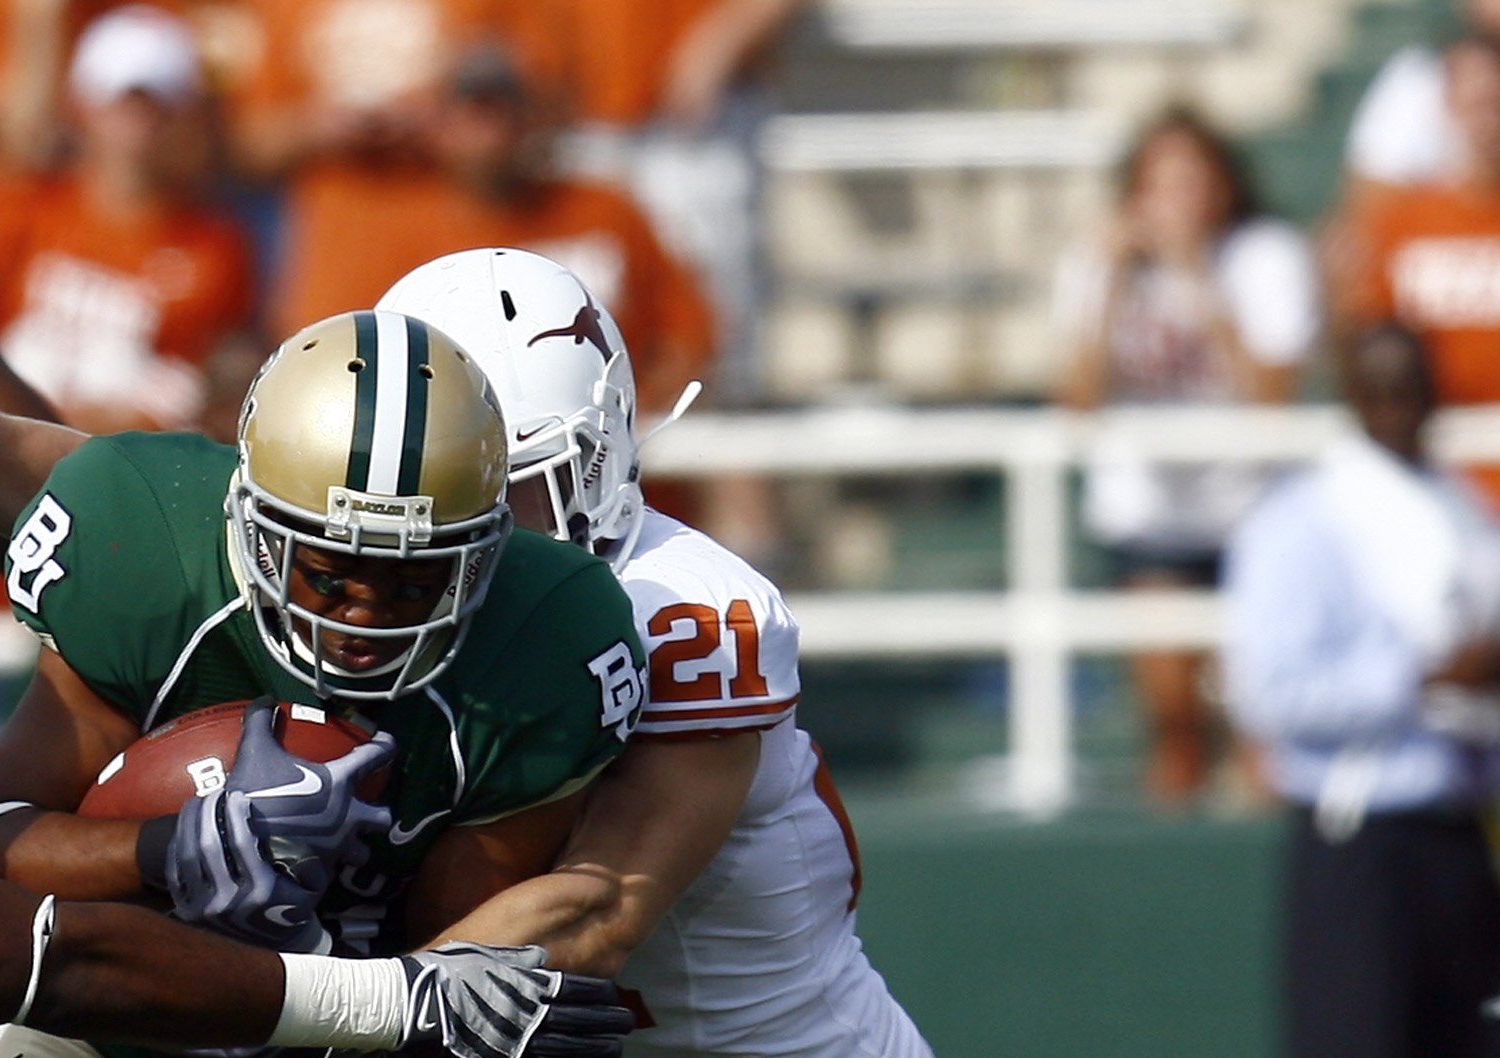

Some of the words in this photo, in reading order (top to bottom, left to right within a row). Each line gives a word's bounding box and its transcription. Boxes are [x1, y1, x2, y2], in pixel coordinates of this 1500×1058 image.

[7, 491, 71, 614] BU
[647, 599, 769, 703] 21
[186, 755, 228, 797] B
